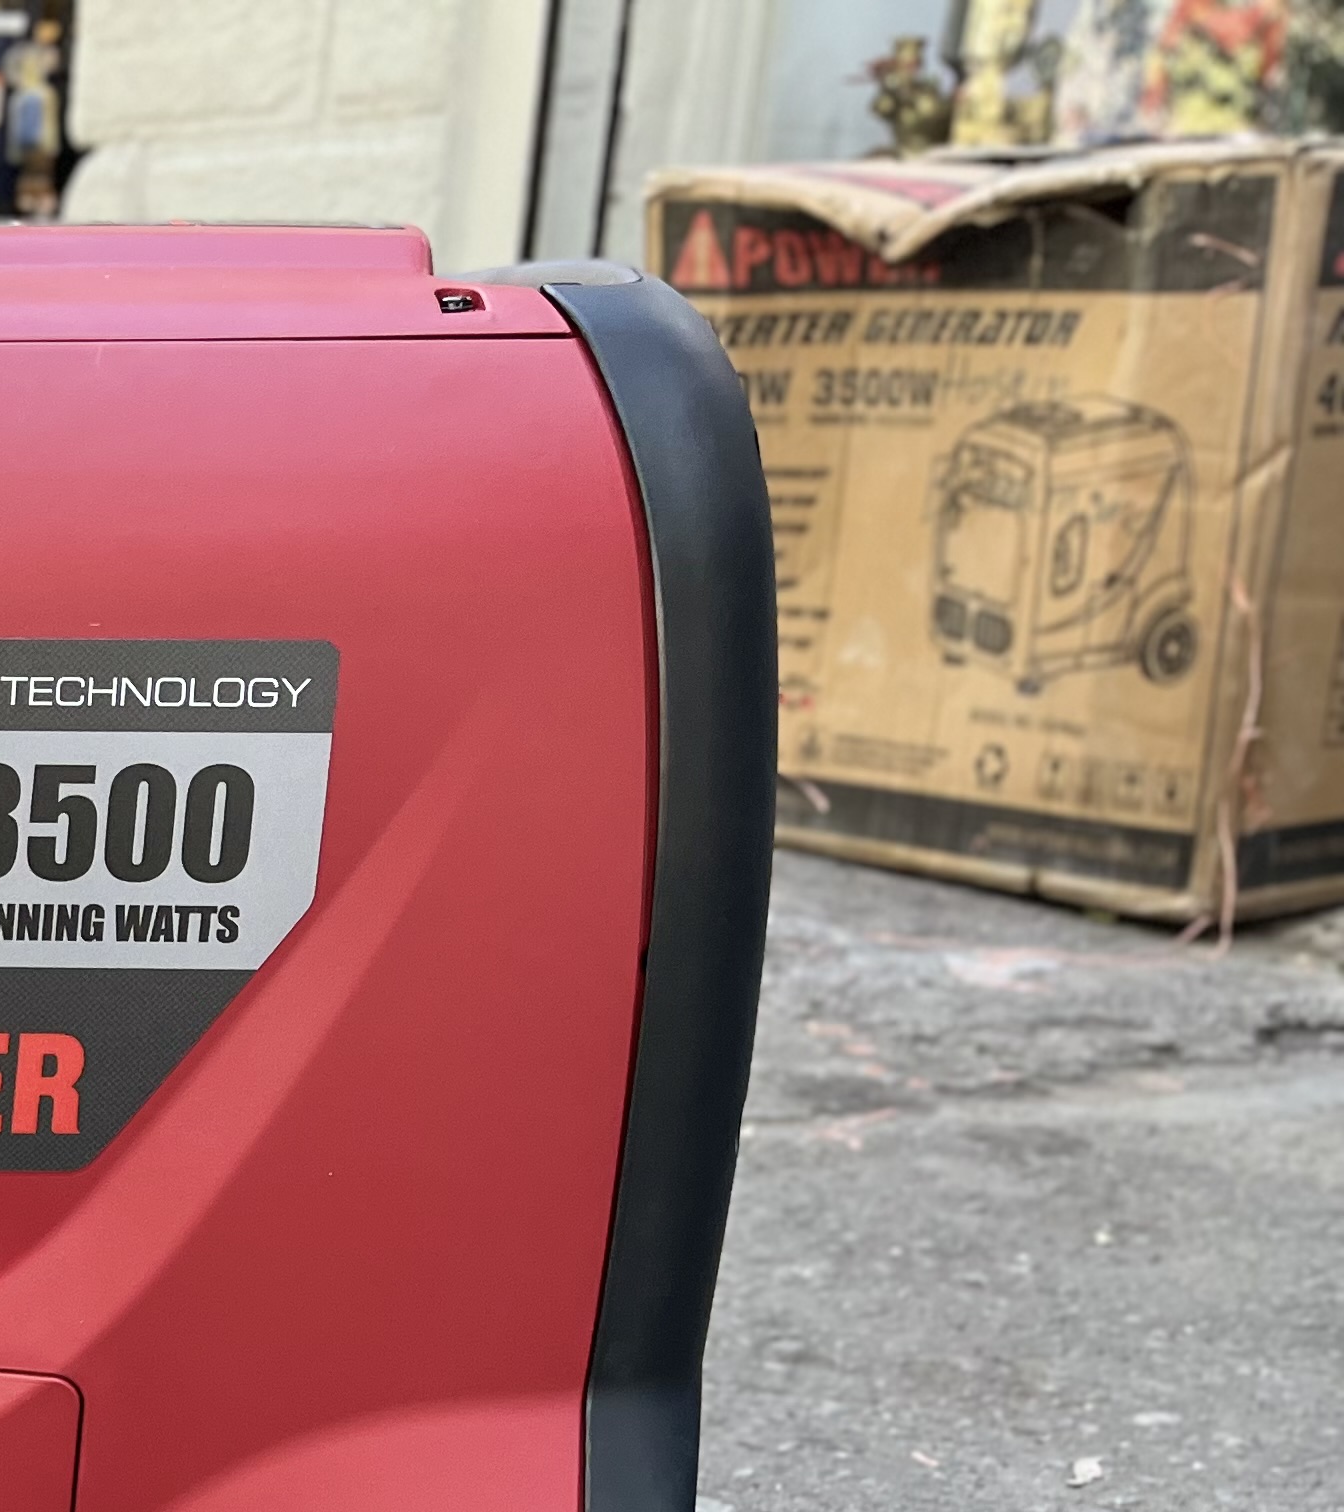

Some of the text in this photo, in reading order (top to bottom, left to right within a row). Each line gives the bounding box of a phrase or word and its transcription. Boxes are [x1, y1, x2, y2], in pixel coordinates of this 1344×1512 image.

[864, 310, 1082, 345] GENERATOR
[0, 674, 313, 709] TECHNOLOGY
[115, 904, 240, 944] WATTS
